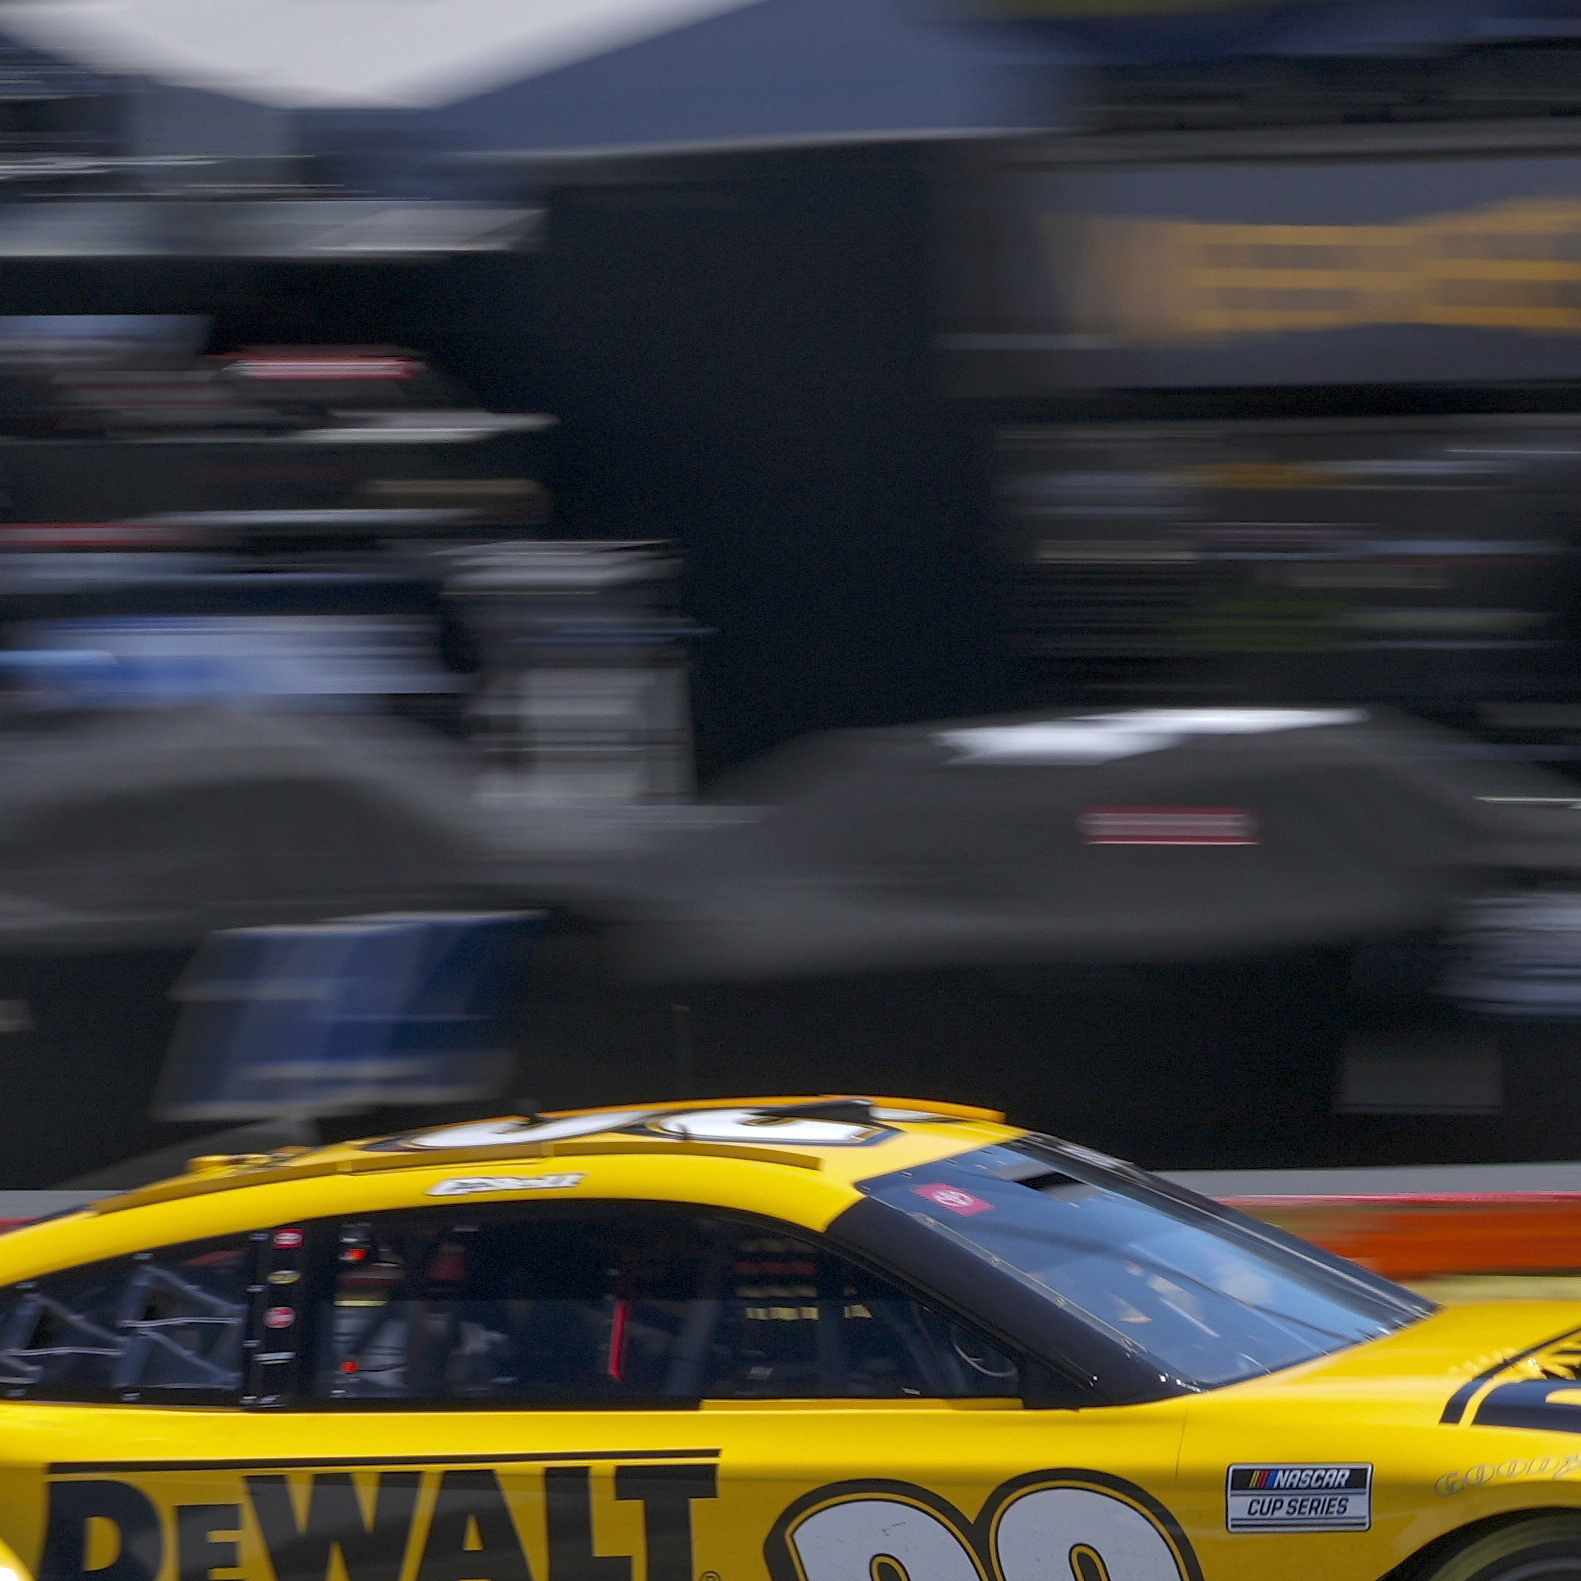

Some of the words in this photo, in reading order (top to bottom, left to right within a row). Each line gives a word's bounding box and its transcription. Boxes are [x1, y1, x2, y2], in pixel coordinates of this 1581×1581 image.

[1273, 1469, 1351, 1489] NASCAR
[1247, 1498, 1284, 1516] CUP
[1285, 1497, 1350, 1516] SERIES
